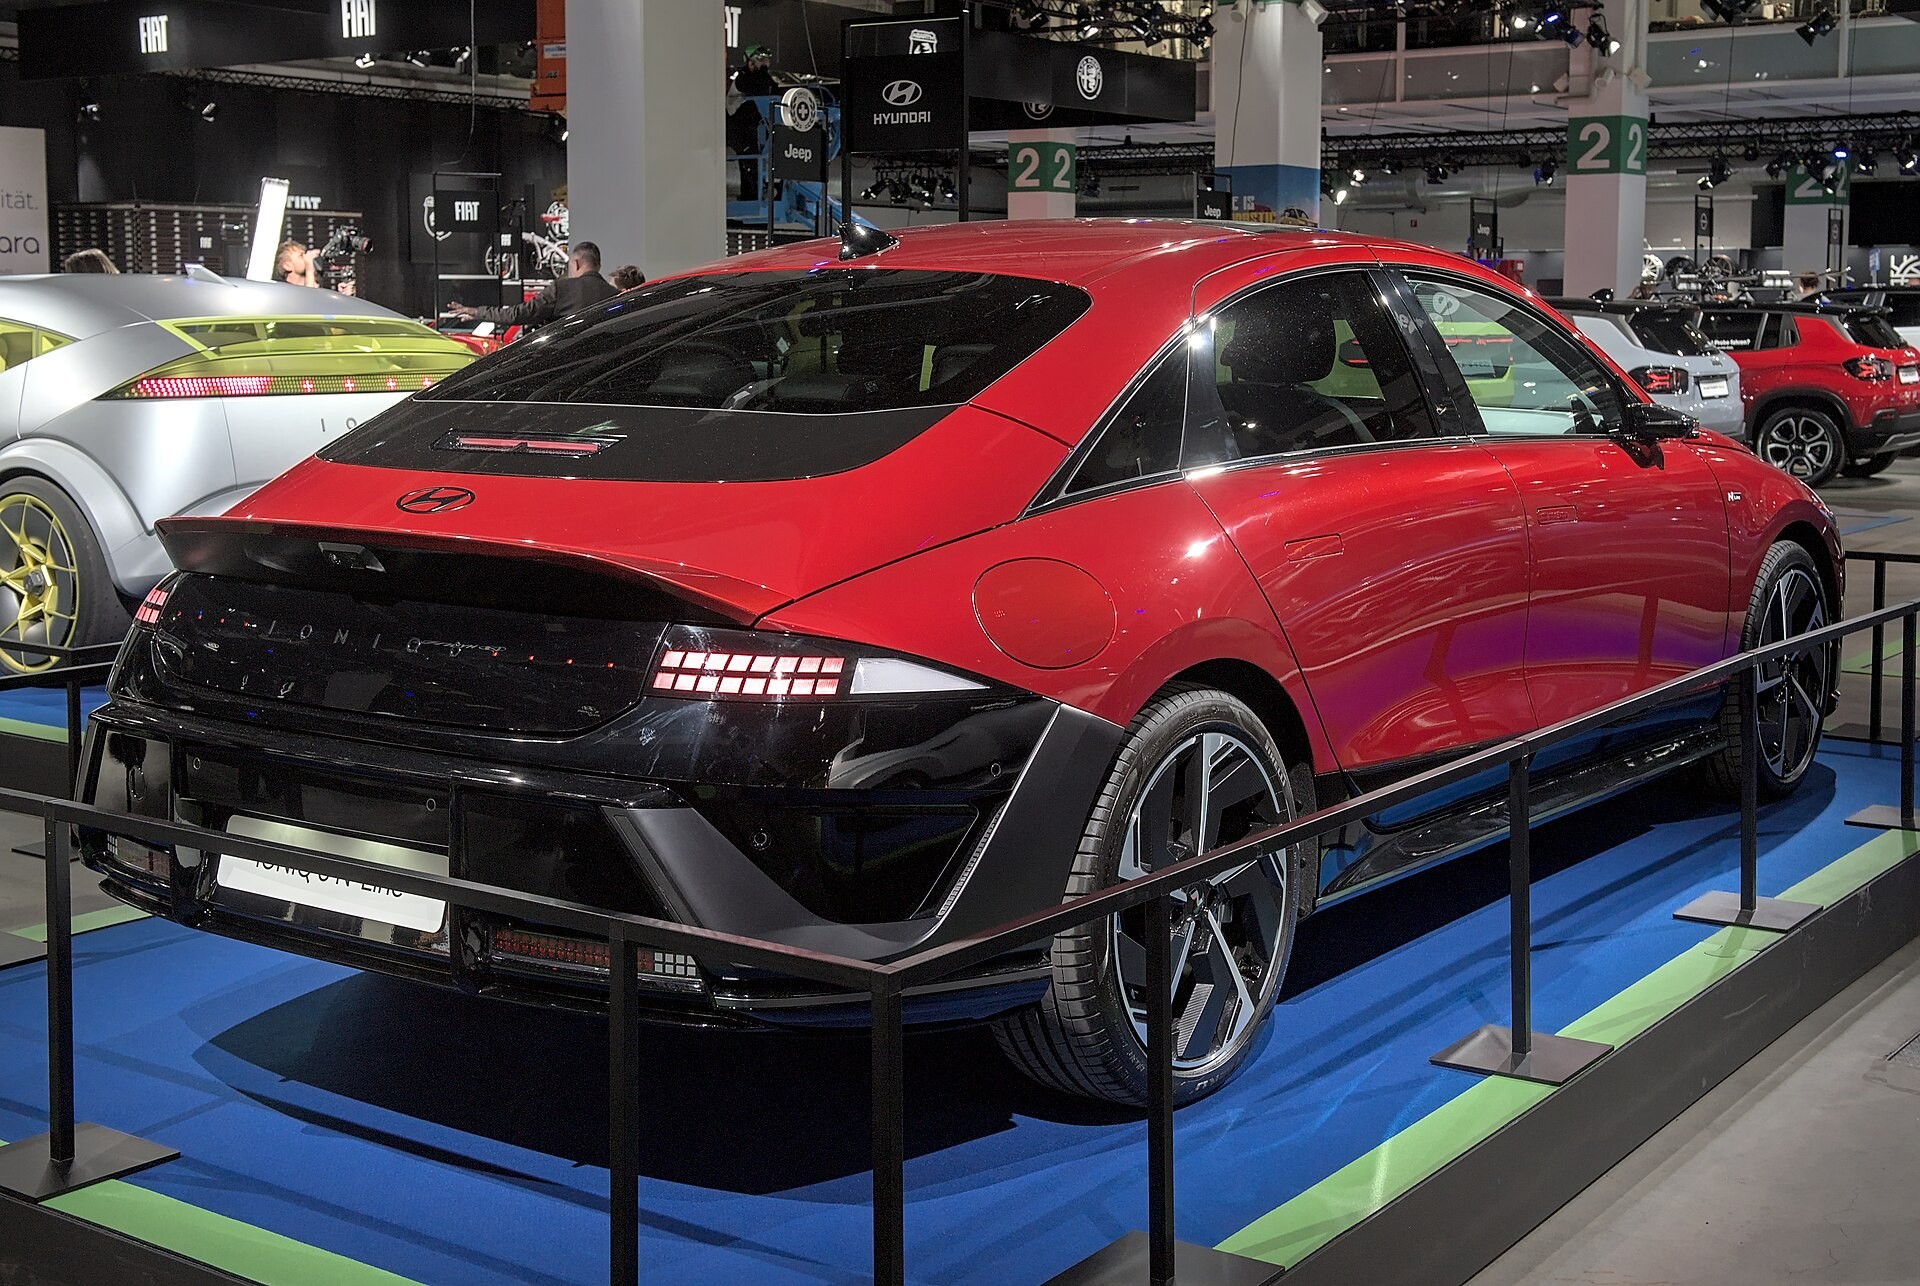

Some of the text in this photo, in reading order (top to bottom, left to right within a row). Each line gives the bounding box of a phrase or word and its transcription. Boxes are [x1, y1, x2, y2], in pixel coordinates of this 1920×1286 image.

[138, 15, 168, 54] FIAT
[873, 111, 931, 125] HYUNDAI
[784, 144, 812, 163] Jeep
[1577, 122, 1610, 169] 2
[1627, 123, 1642, 170] 2
[1015, 147, 1040, 187] 2
[1053, 148, 1070, 188] 2
[454, 201, 480, 221] FIAT
[1204, 205, 1221, 219] Jeep
